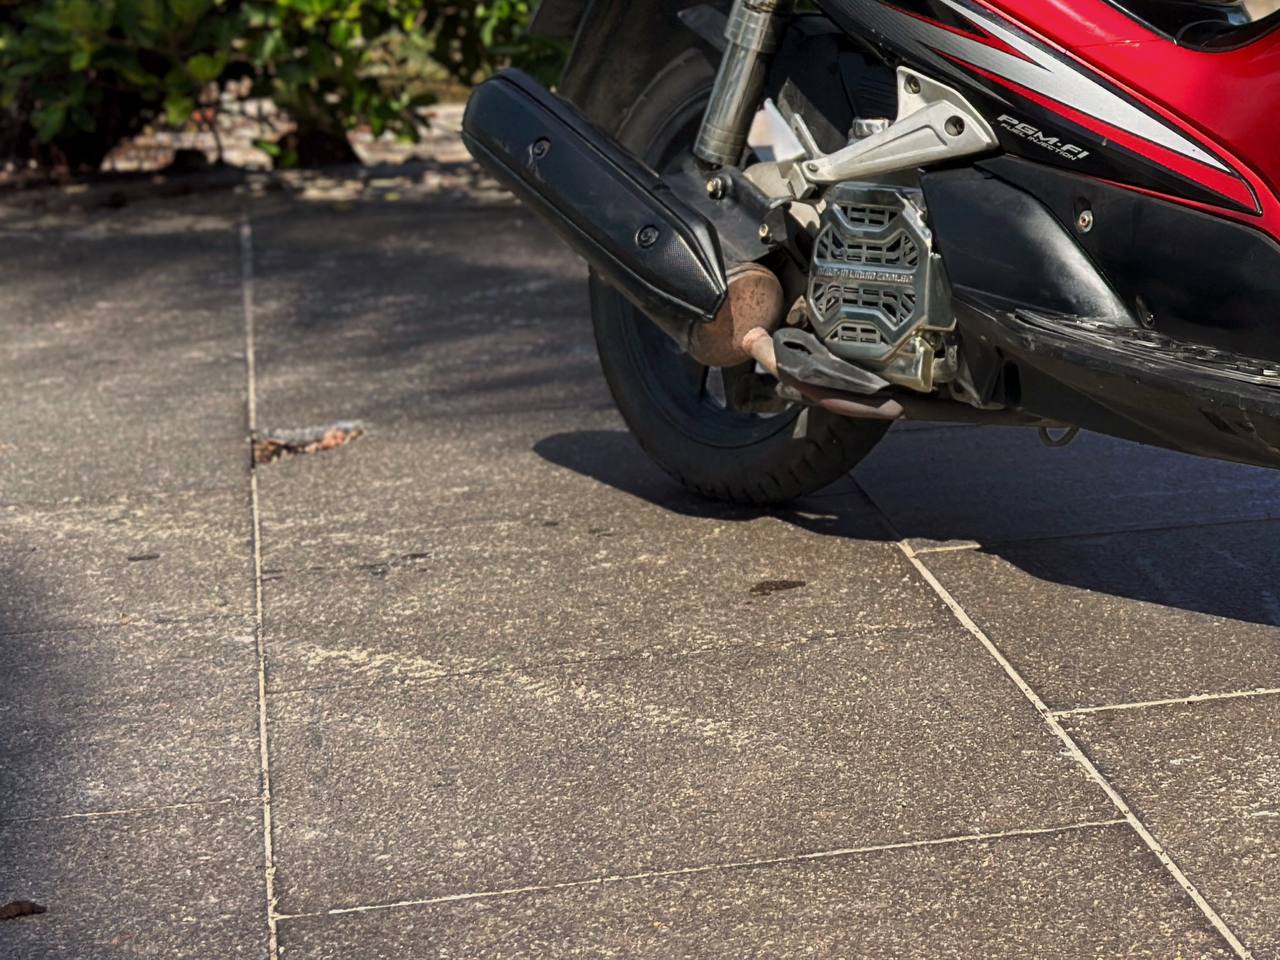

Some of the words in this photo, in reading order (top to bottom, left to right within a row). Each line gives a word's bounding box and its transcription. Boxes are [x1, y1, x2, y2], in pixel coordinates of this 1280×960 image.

[997, 114, 1090, 159] PGM-FI
[1000, 123, 1026, 138] FUEL
[1027, 136, 1077, 161] INJECTION
